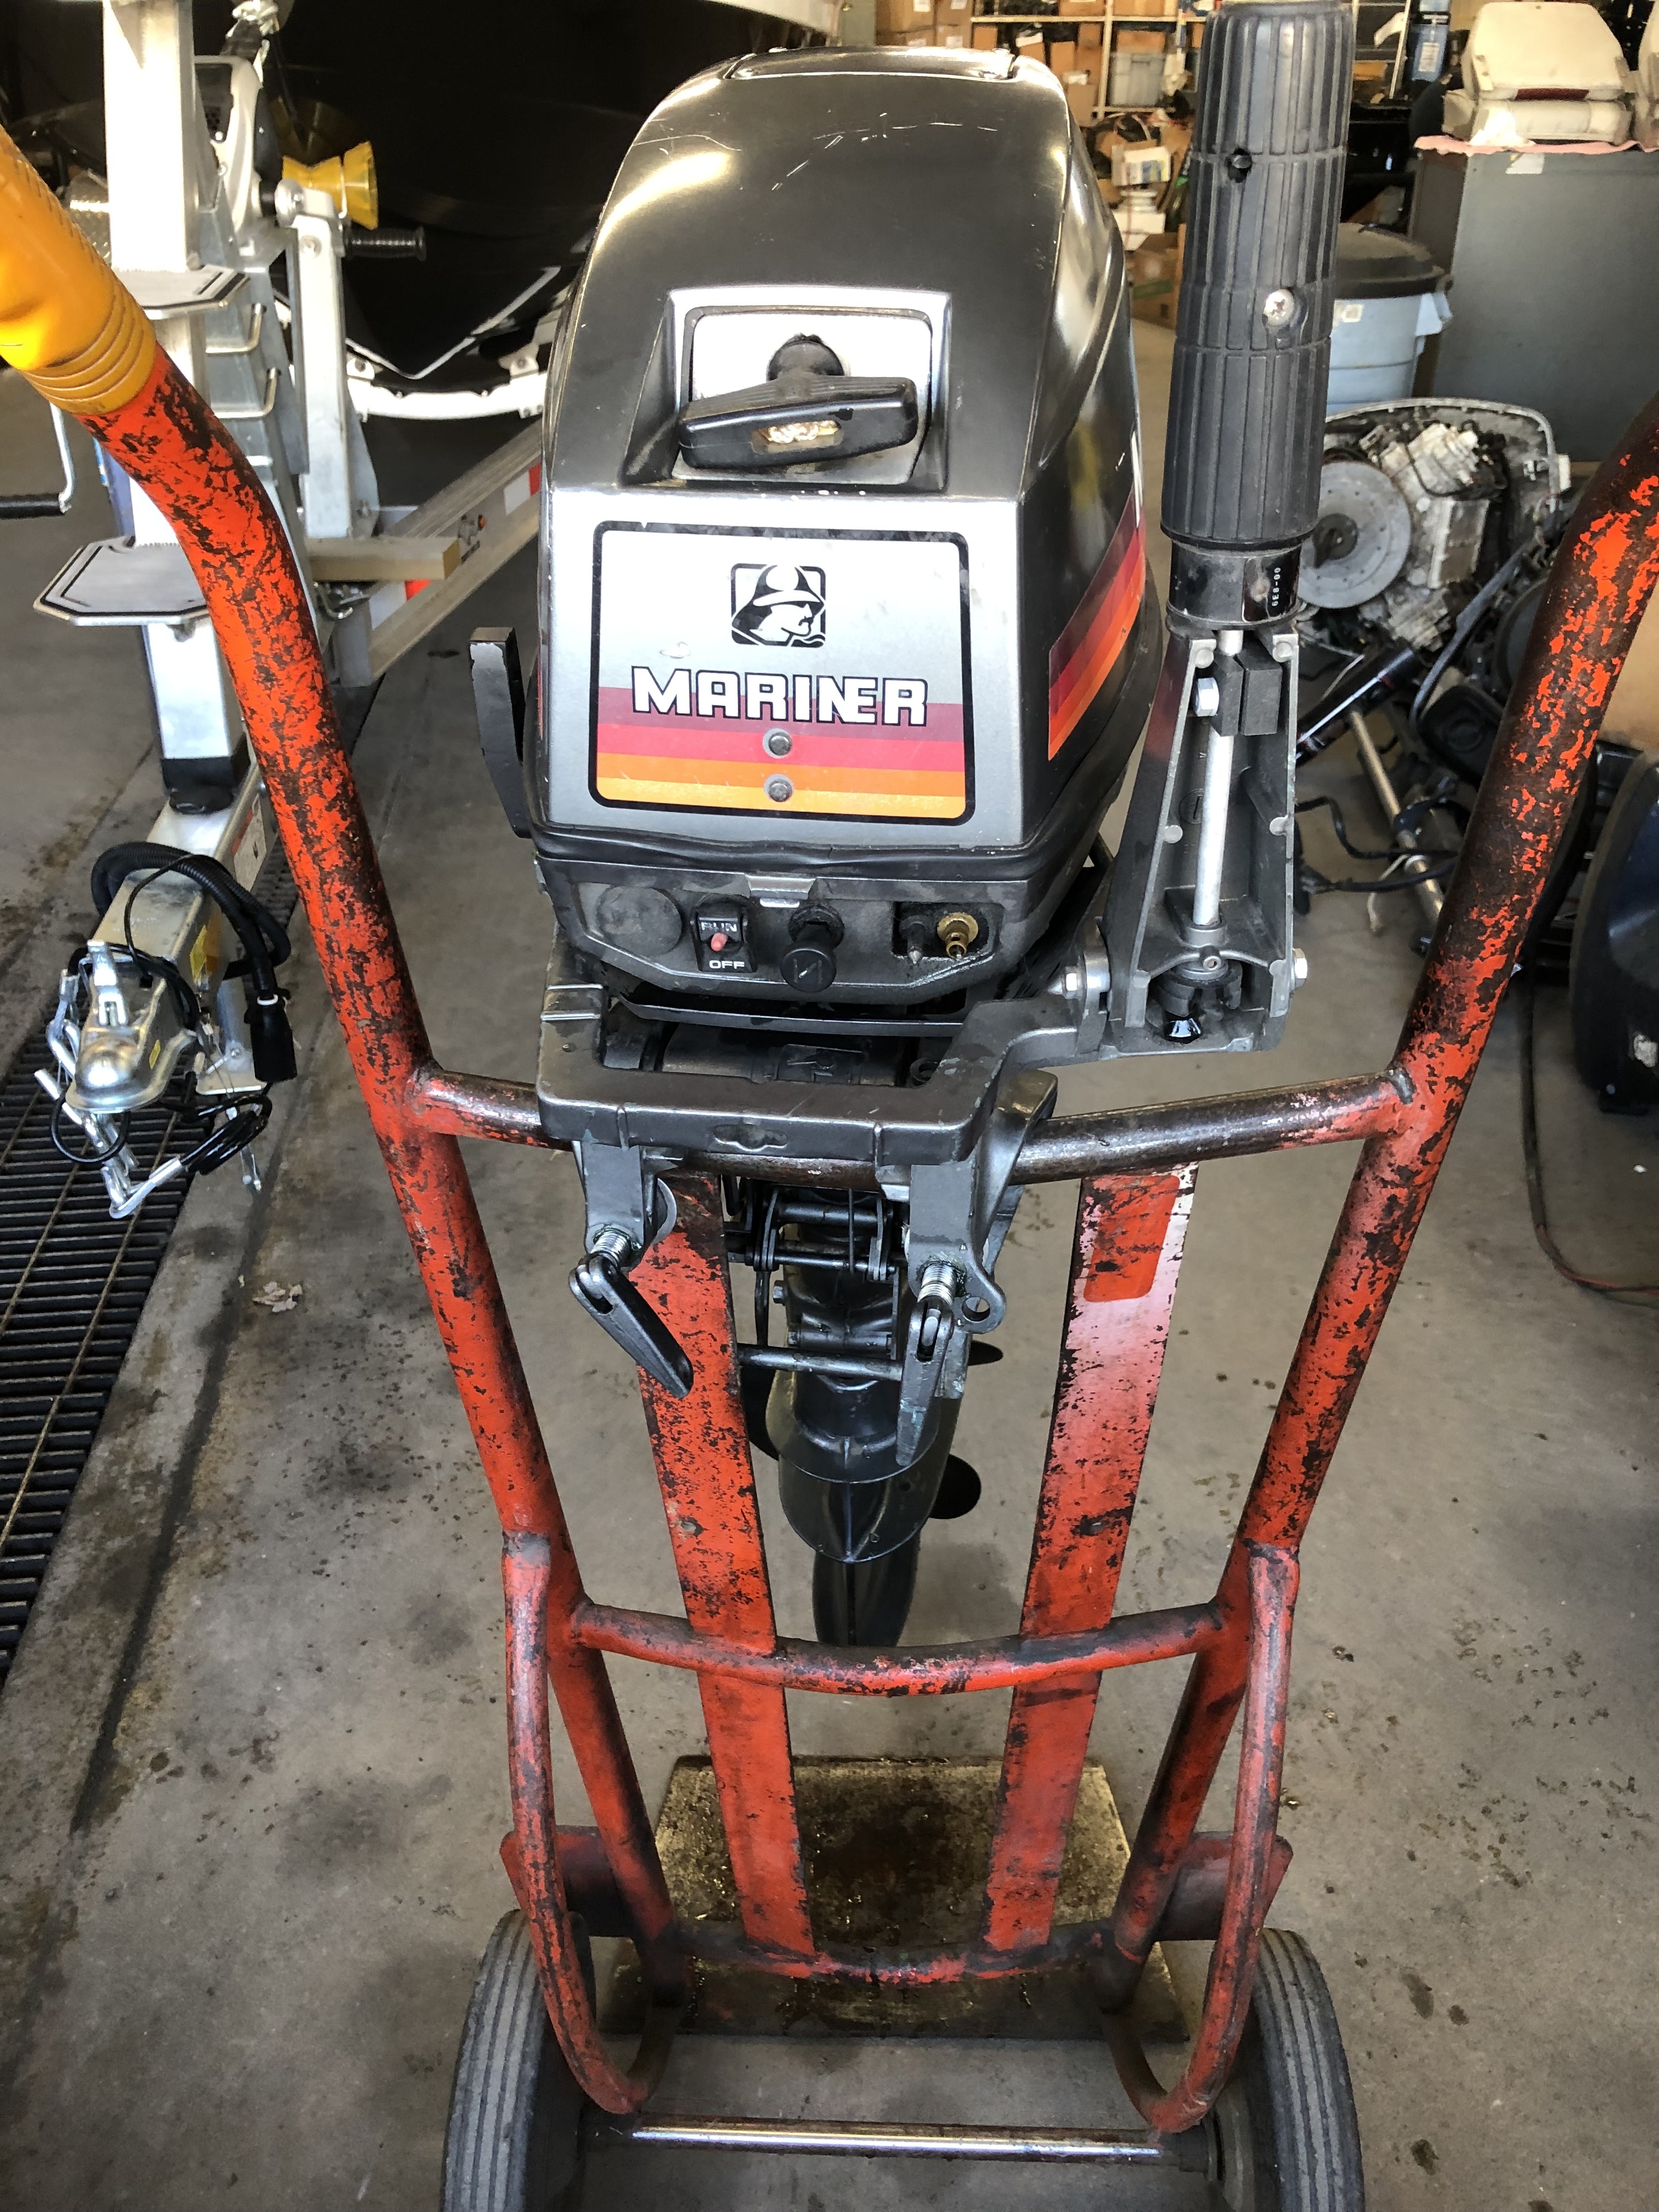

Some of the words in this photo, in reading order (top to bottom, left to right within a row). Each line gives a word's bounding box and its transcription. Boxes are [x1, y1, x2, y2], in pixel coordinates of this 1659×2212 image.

[1271, 567, 1281, 607] 6E8-00
[631, 665, 928, 726] MARINER
[701, 922, 737, 932] RUN
[709, 960, 745, 969] OFF
